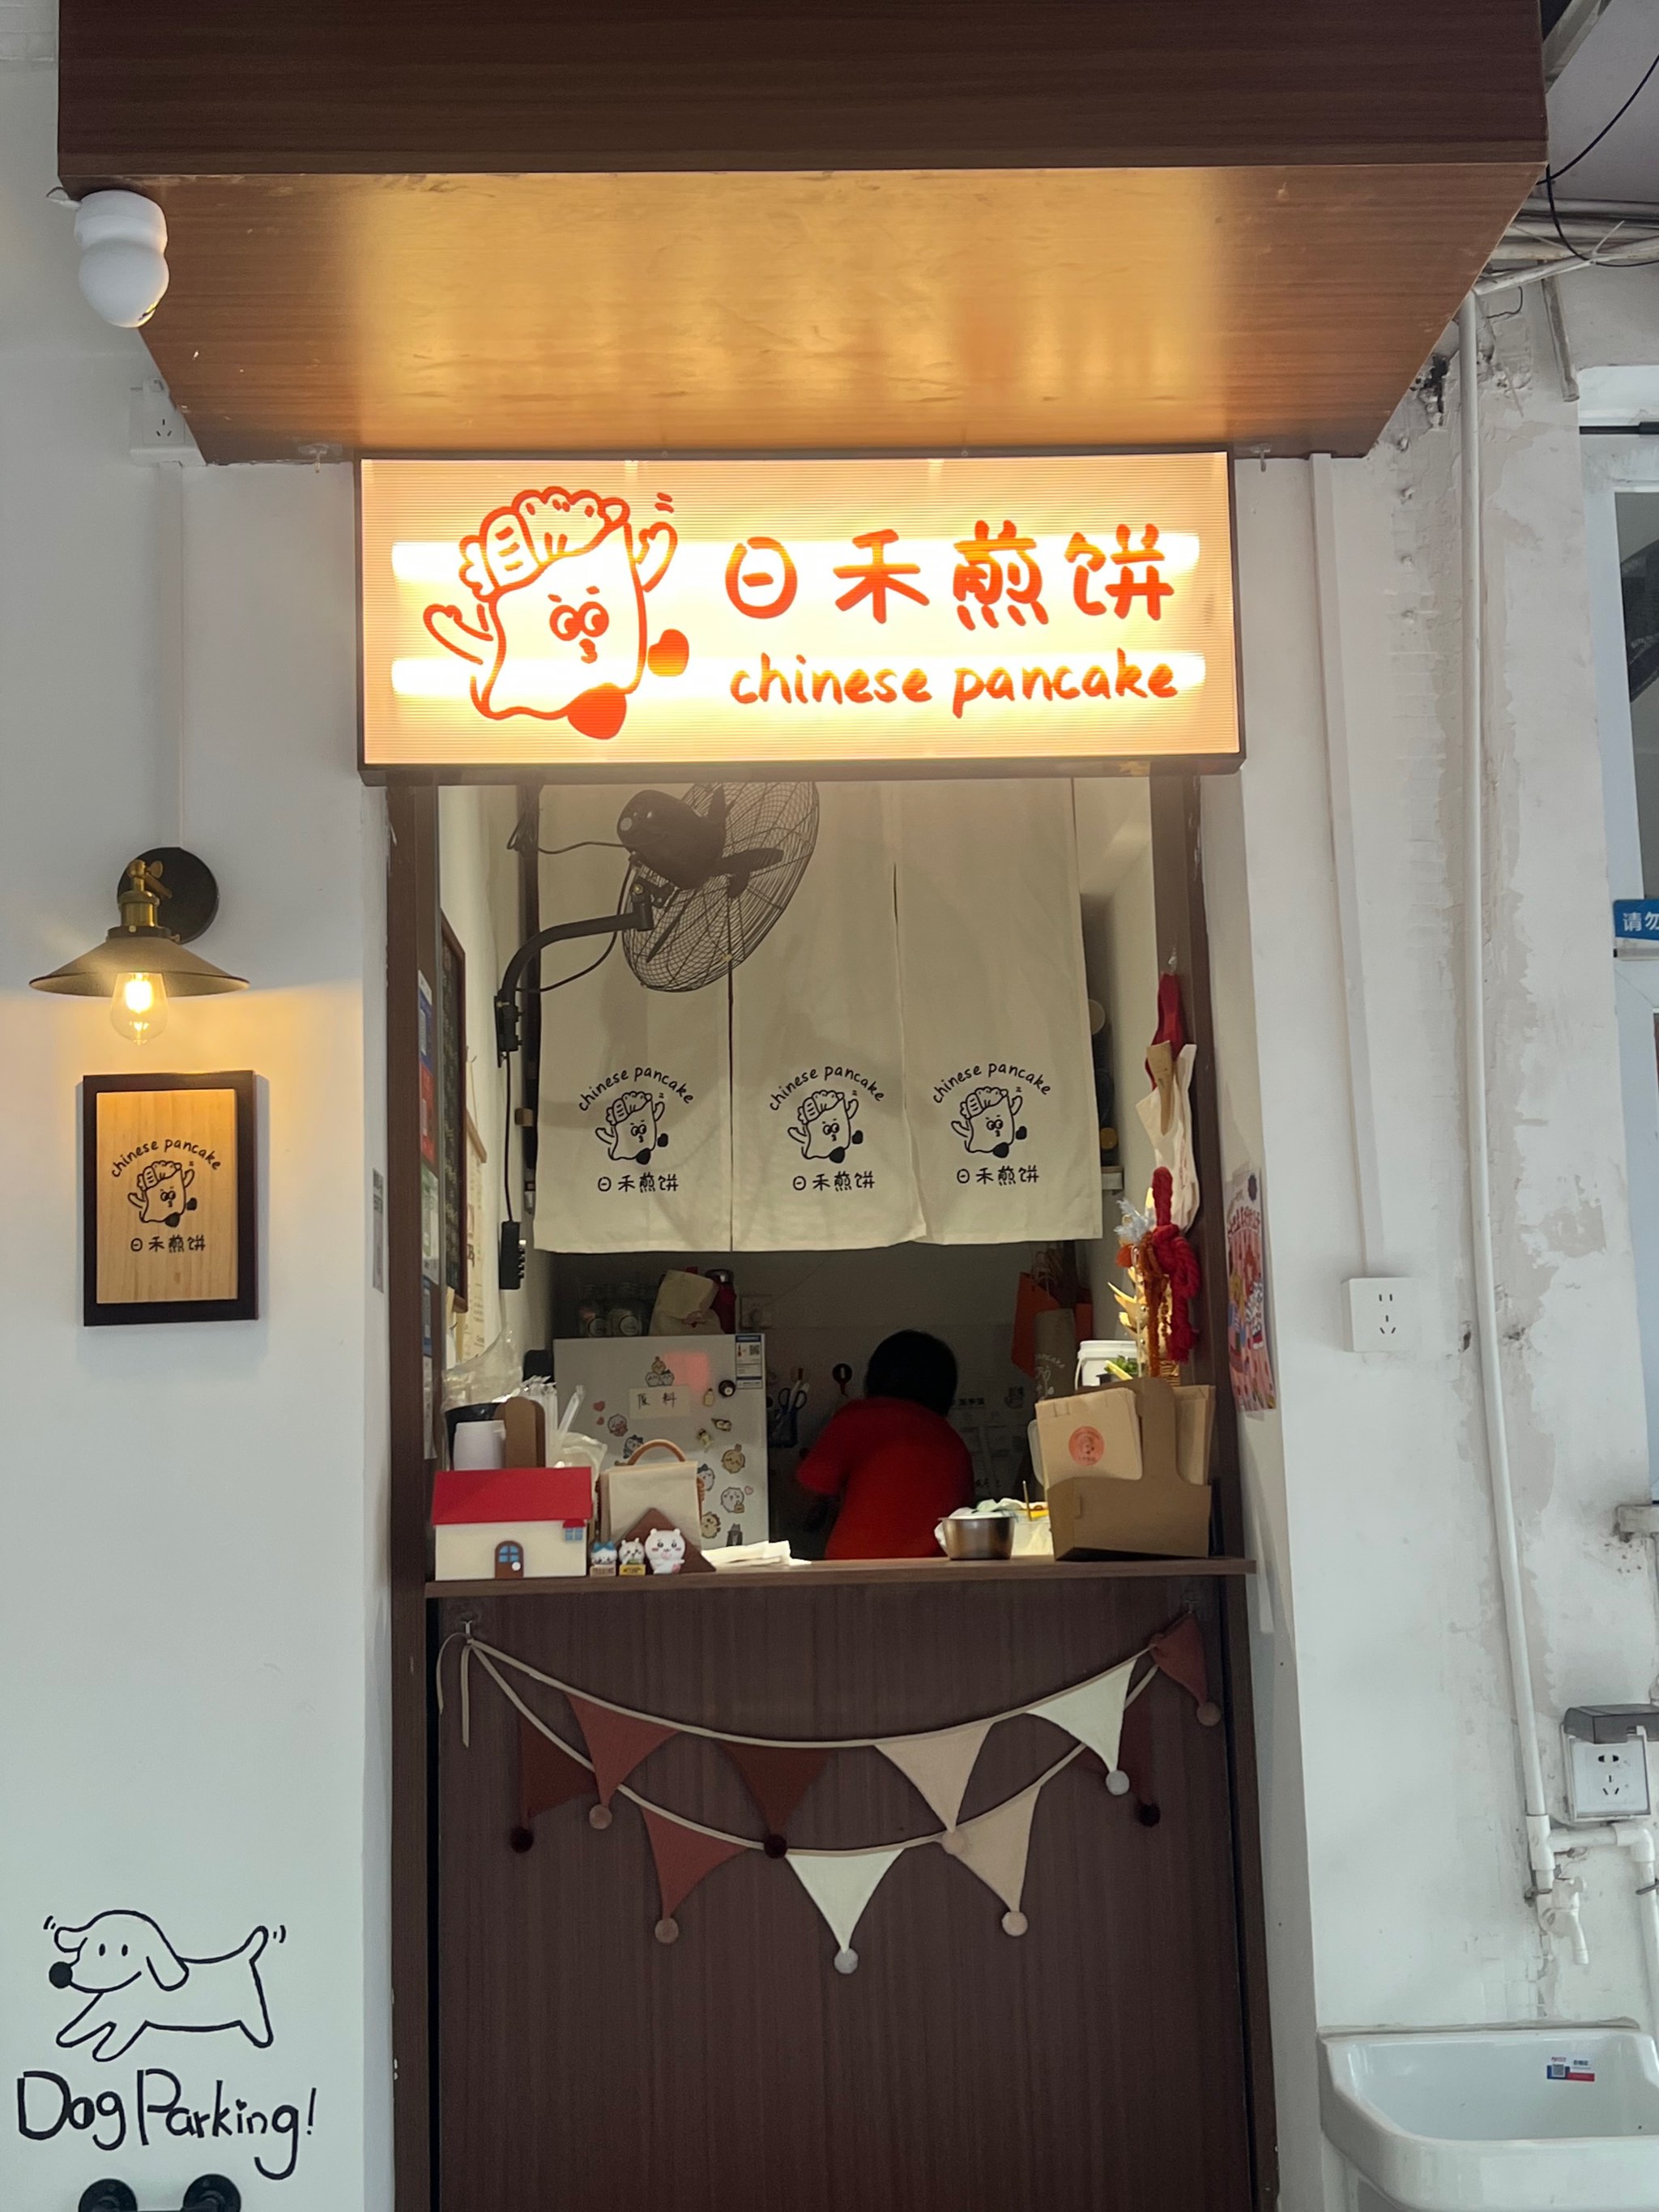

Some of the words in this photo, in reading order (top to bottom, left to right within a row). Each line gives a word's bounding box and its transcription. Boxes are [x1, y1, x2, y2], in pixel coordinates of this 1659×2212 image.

[724, 519, 1175, 630] 日禾煎饼
[730, 652, 932, 705] chinese
[952, 648, 1178, 718] pancake
[579, 1070, 629, 1111] chinese
[634, 1066, 693, 1104] pancake
[770, 1069, 818, 1111] chinese
[824, 1065, 885, 1102] pancake
[933, 1065, 982, 1104] chinese
[988, 1063, 1051, 1095] pancake
[112, 1139, 159, 1177] chinese
[164, 1138, 222, 1171] pancake
[957, 1165, 1039, 1186] 日禾煎饼
[598, 1172, 679, 1193] 日禾煎饼
[793, 1171, 875, 1192] 日禾煎饼
[130, 1235, 206, 1253] 日禾煎饼
[17, 2071, 126, 2151] Dog
[137, 2069, 317, 2180] Parking!
